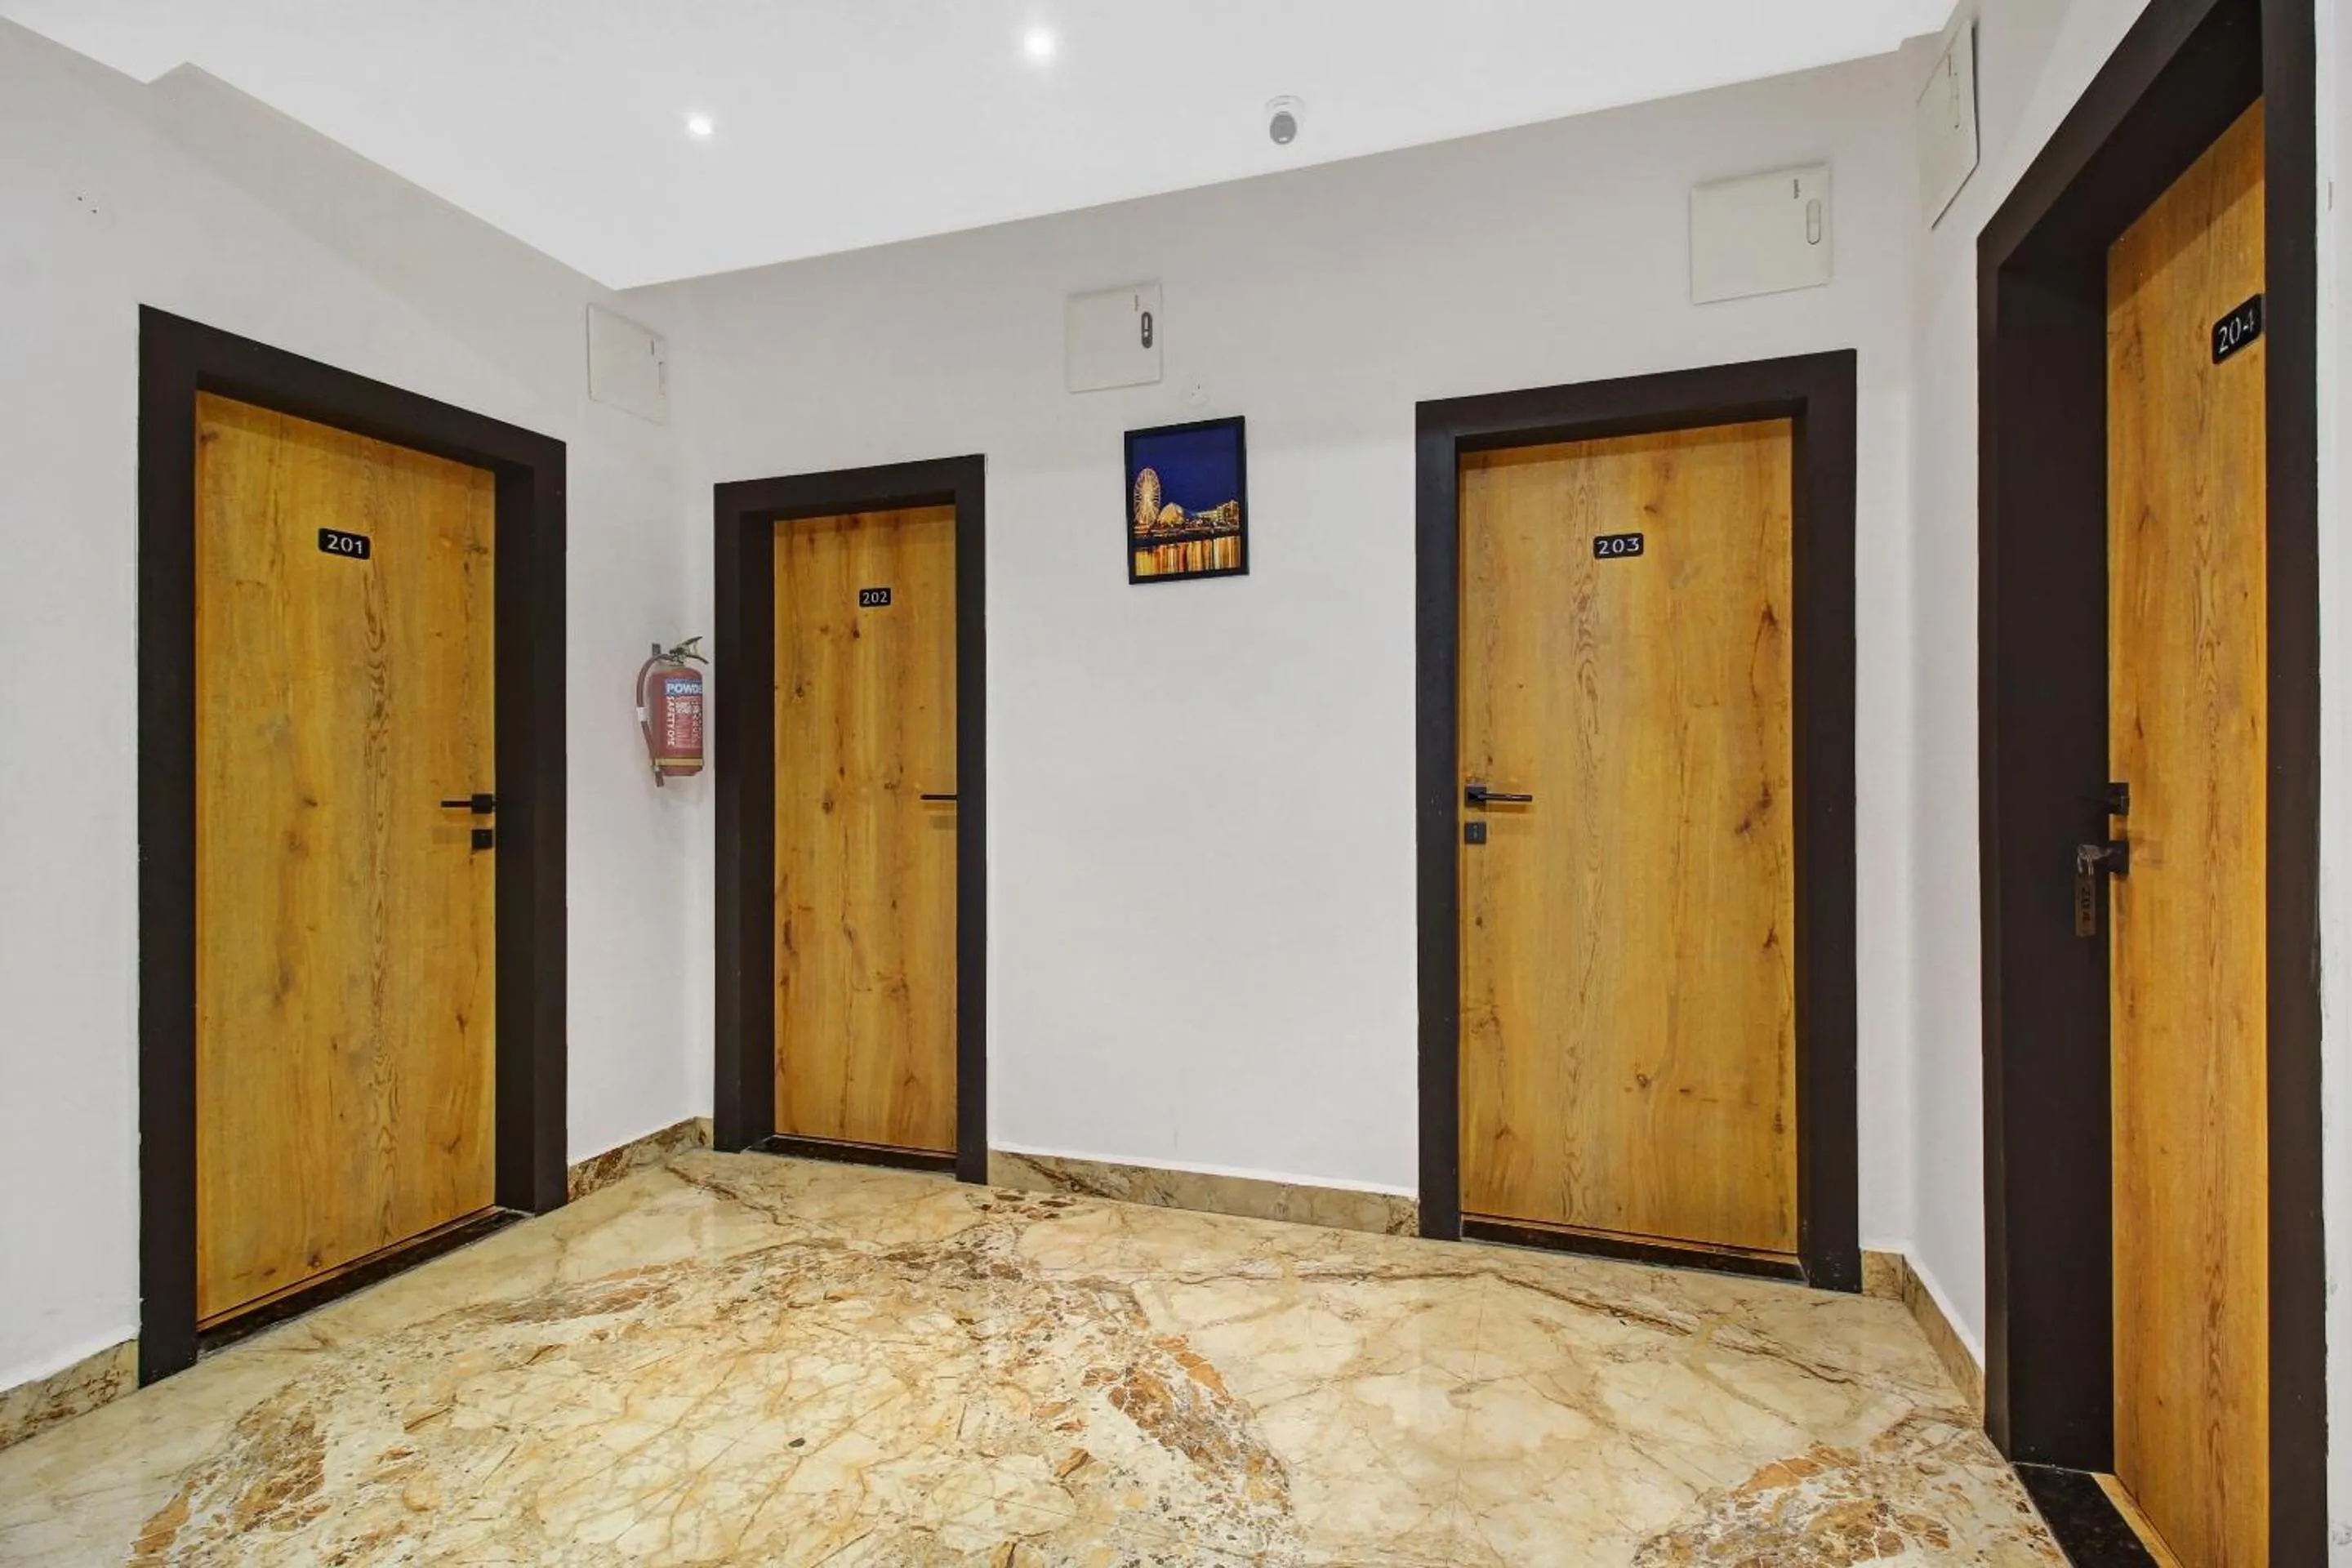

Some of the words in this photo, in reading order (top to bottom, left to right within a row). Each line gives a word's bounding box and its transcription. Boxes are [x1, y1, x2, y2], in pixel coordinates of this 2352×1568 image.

[327, 534, 363, 555] 201
[1597, 537, 1640, 555] 203
[862, 590, 888, 604] 202
